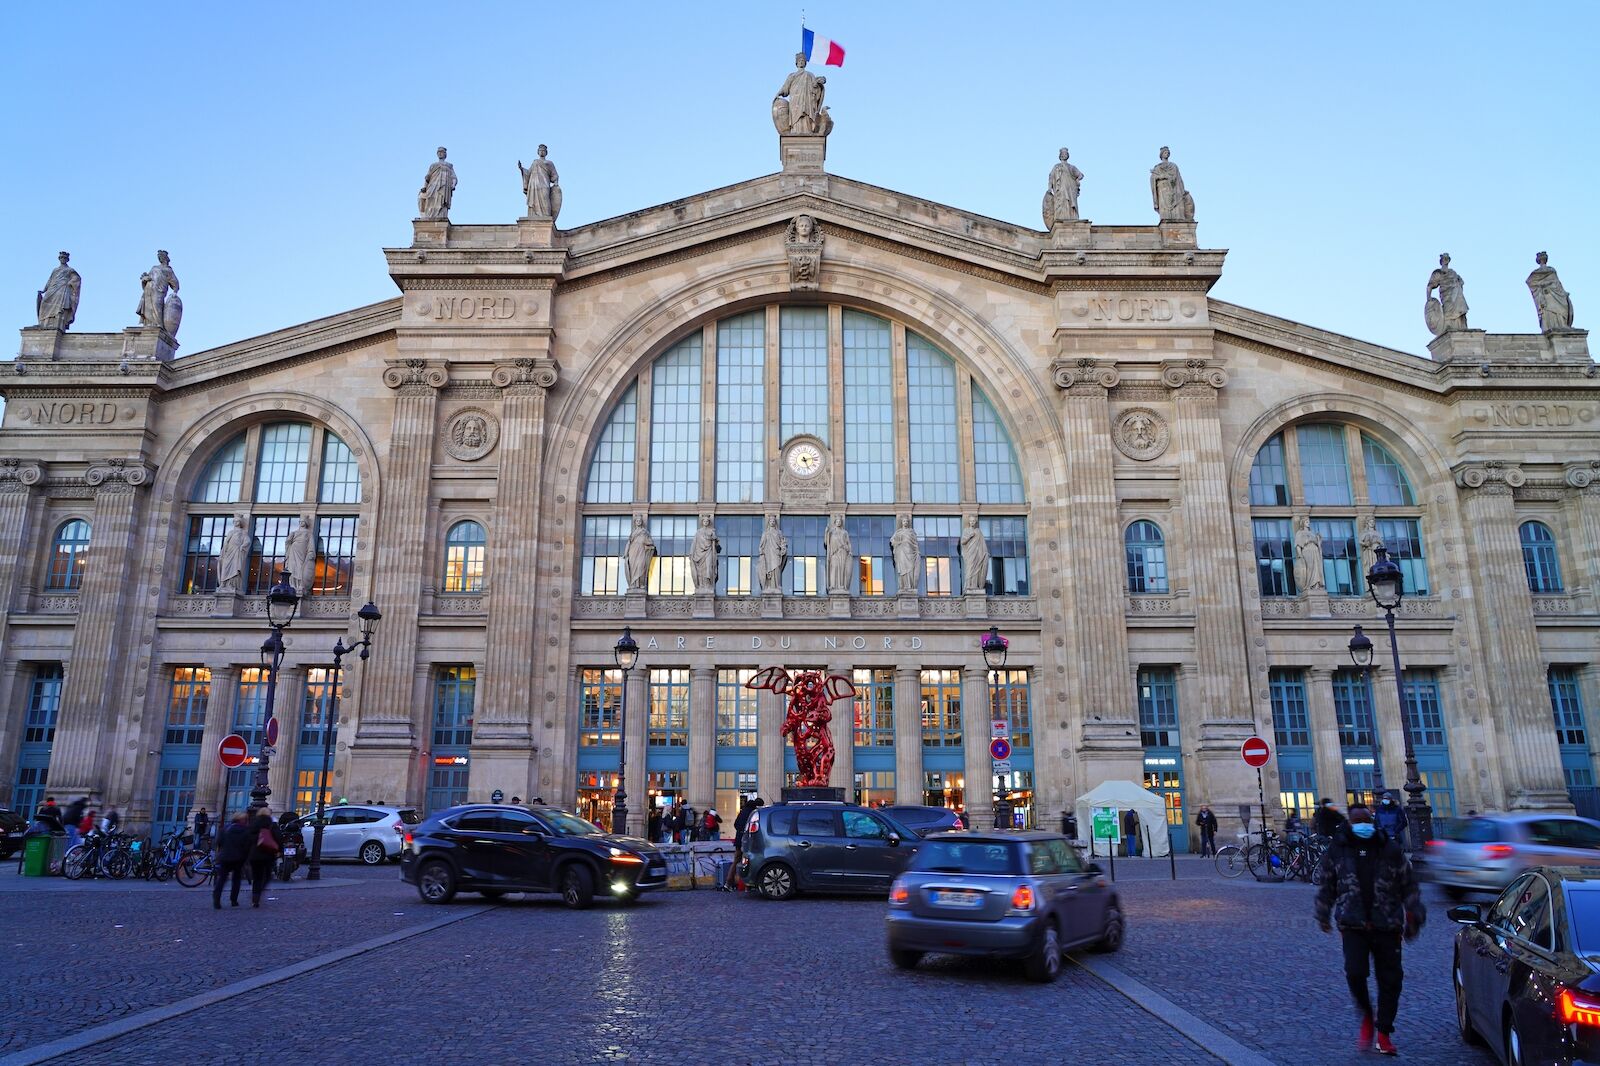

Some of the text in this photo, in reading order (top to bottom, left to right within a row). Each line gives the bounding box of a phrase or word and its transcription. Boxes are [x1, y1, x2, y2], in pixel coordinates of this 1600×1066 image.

[434, 296, 516, 320] NORD
[1092, 299, 1174, 321] NORD
[35, 403, 118, 425] NORD
[1490, 405, 1575, 427] NORD
[647, 636, 923, 650] ARE DU NORD
